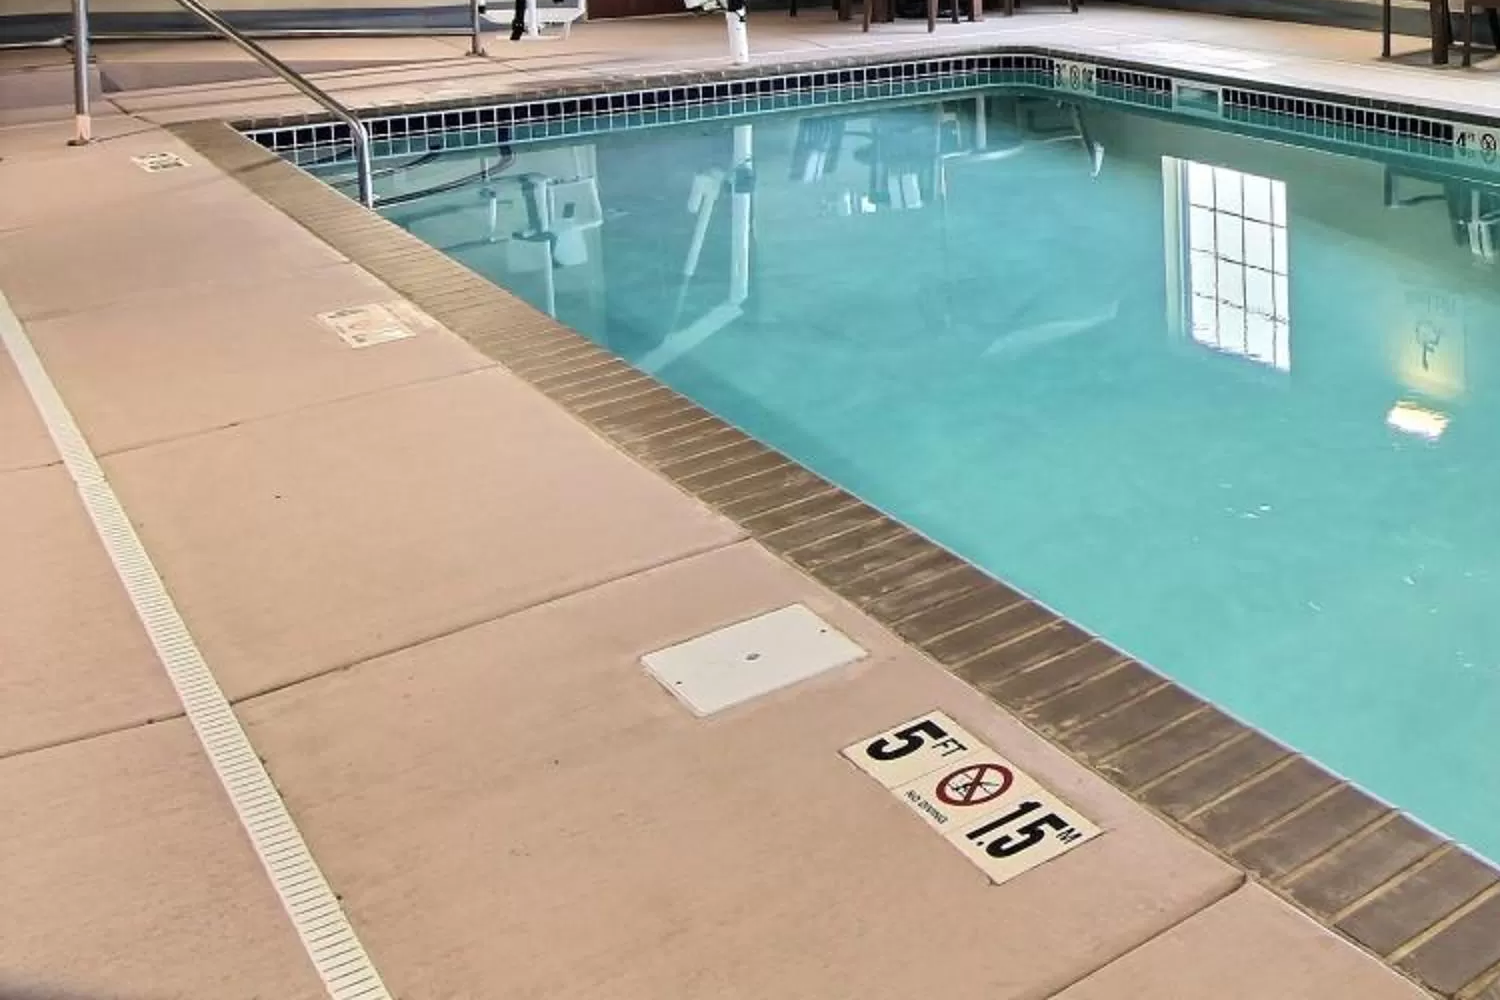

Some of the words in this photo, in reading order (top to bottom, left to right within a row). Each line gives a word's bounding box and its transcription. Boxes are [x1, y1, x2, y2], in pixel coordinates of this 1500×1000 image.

[866, 719, 948, 761] 5
[931, 737, 969, 758] FT
[965, 801, 1069, 859] 1.5
[1055, 827, 1083, 846] M
